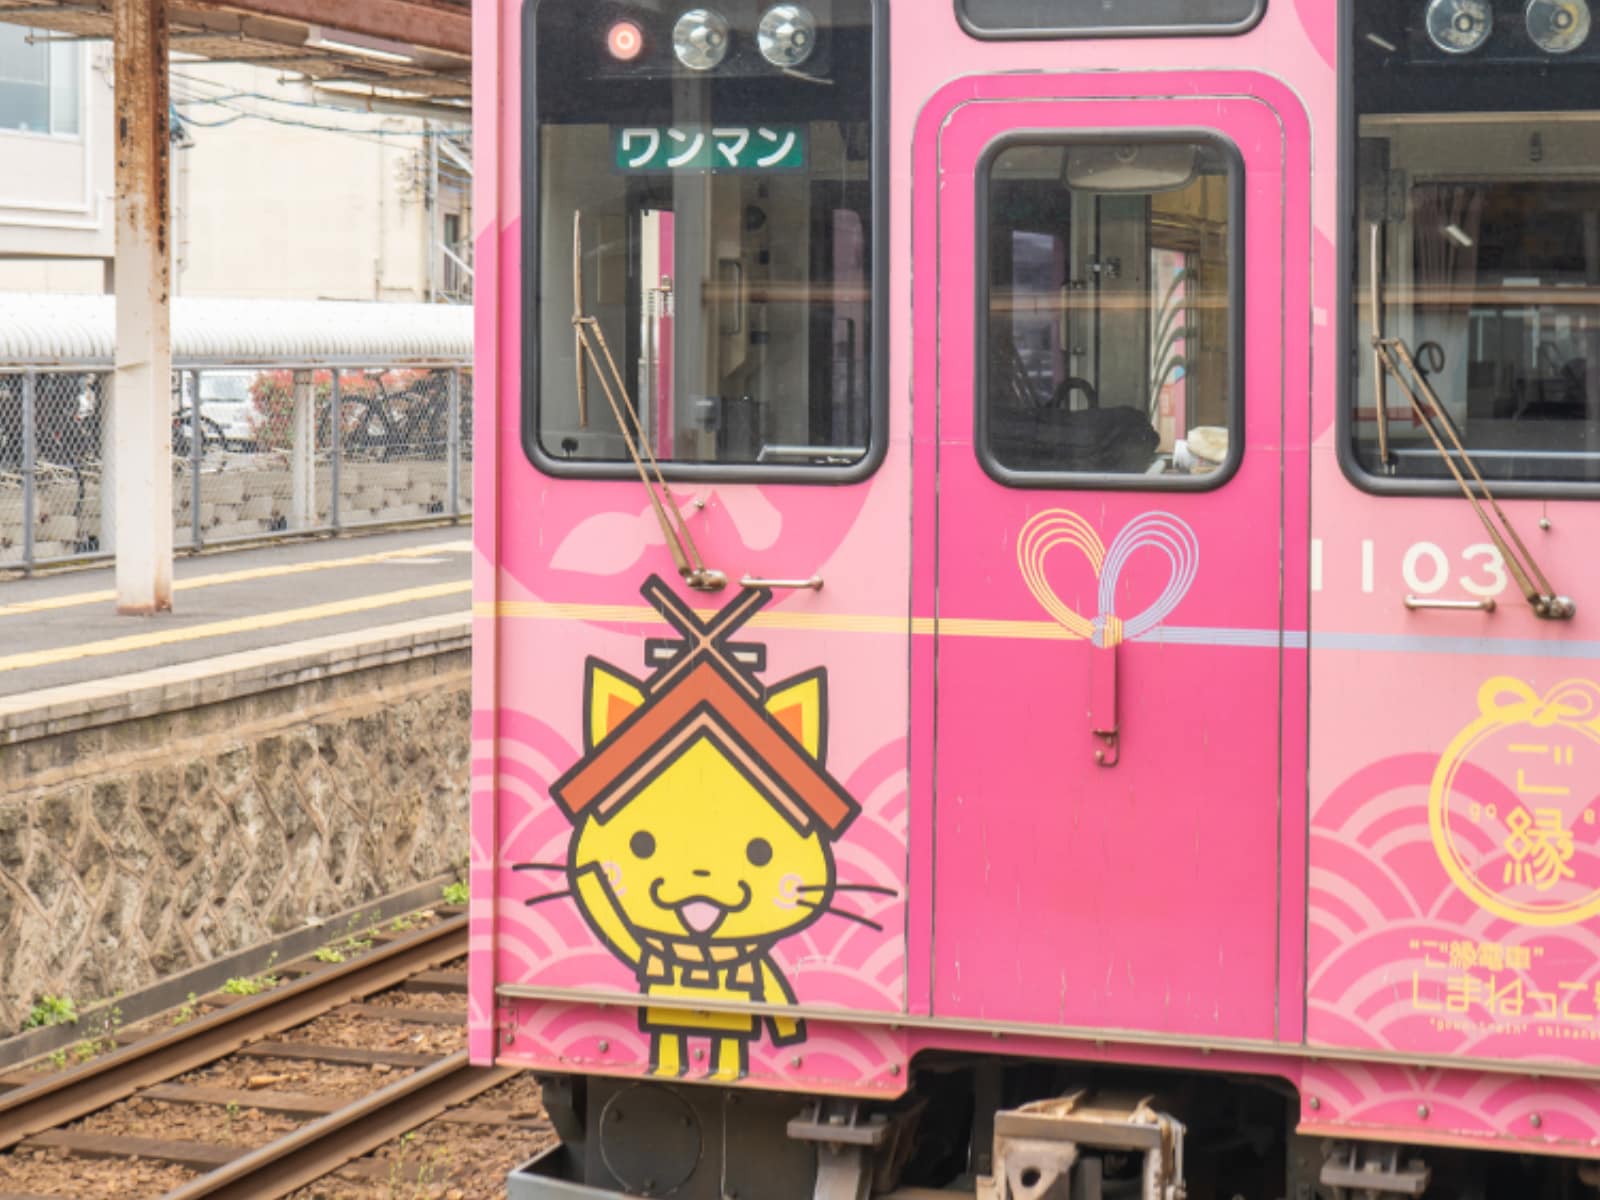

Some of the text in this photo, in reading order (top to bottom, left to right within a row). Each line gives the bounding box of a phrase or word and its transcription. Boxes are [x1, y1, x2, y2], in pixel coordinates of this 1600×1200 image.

[622, 128, 795, 167] ワンマン
[1311, 539, 1508, 596] 1103
[1503, 743, 1576, 891] ご縁
[1413, 970, 1600, 1022] しまねっこ
